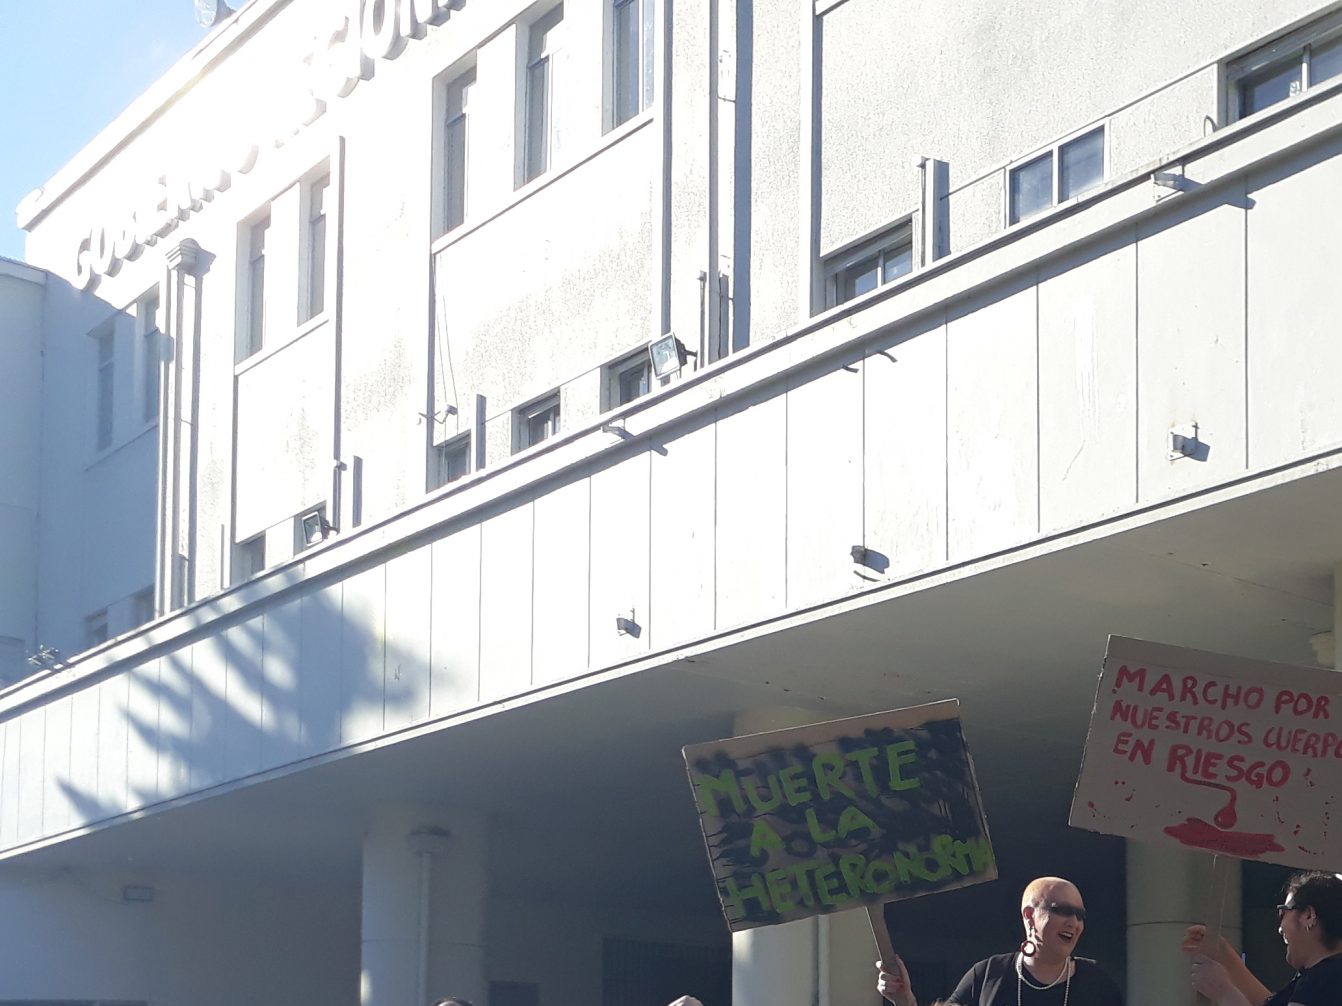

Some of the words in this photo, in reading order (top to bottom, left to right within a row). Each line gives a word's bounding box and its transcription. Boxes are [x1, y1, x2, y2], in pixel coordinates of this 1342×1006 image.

[1114, 665, 1265, 710] MARCHO
[1275, 690, 1331, 719] POR
[1110, 700, 1253, 745] NUESTROS
[698, 740, 921, 818] MUERTE
[1112, 731, 1156, 765] EN
[1166, 743, 1292, 789] RIESGO
[751, 820, 785, 858] A
[806, 806, 881, 843] LA
